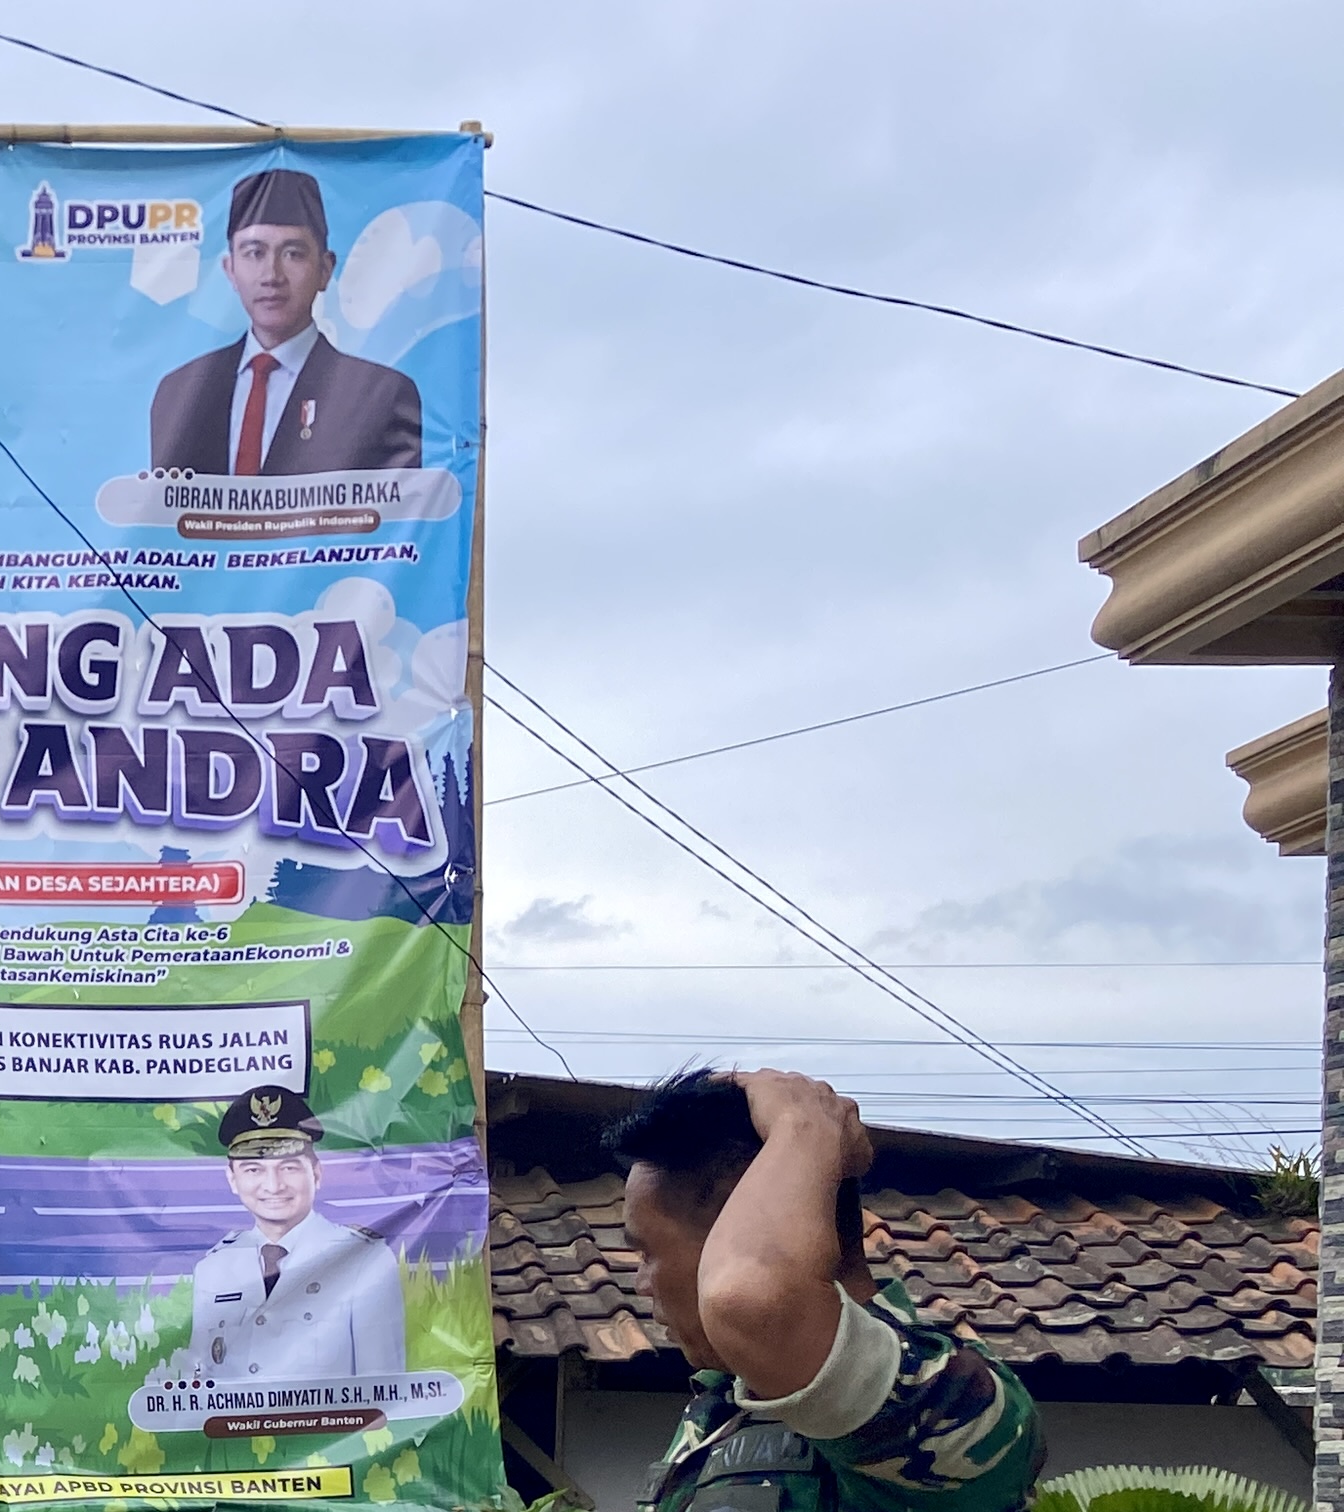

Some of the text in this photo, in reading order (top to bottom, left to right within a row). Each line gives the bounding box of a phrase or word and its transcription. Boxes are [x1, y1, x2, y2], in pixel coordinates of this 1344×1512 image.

[68, 203, 198, 230] DPUPR
[67, 231, 200, 245] PROVINSI BANTEN
[164, 480, 401, 510] GIBRAN RAKABUMING RAKA
[184, 519, 213, 531] Wakil
[215, 520, 262, 532] Presiden
[319, 513, 375, 527] Indonesia
[133, 551, 216, 569] ADALAH
[227, 545, 420, 569] BERKELANJUTAN,
[12, 574, 61, 590] KITA
[67, 573, 180, 590] KERJAKAN.
[148, 620, 378, 709] ADA
[5, 721, 434, 848] ANDRA
[26, 875, 83, 892] DESA
[88, 872, 220, 893] SEJAHTERA)
[97, 927, 139, 942] Asta
[144, 927, 180, 942] Cita
[186, 927, 229, 942] ke-6
[3, 948, 64, 962] Bawah
[70, 948, 125, 963] Untuk
[131, 941, 331, 963] PemerataanEkonomi
[336, 940, 350, 955] &
[9, 1030, 152, 1050] KONEKTIVITAS
[159, 1032, 213, 1049] RUAS
[219, 1029, 289, 1049] JALAN
[13, 1056, 89, 1074] BANJAR
[94, 1058, 141, 1075] KAB.
[146, 1053, 294, 1074] PANDEGLANG
[147, 1395, 169, 1413] DR.
[172, 1394, 186, 1411] H.
[190, 1393, 203, 1410] R.
[207, 1390, 264, 1411] ACHMAD
[269, 1388, 321, 1408] DIMYATI
[324, 1387, 338, 1404] N.
[227, 1416, 363, 1431] Wakil Gubernur Banten
[53, 1481, 113, 1495] APBD
[120, 1481, 223, 1496] PROVINSI
[231, 1476, 322, 1494] BANTEN
